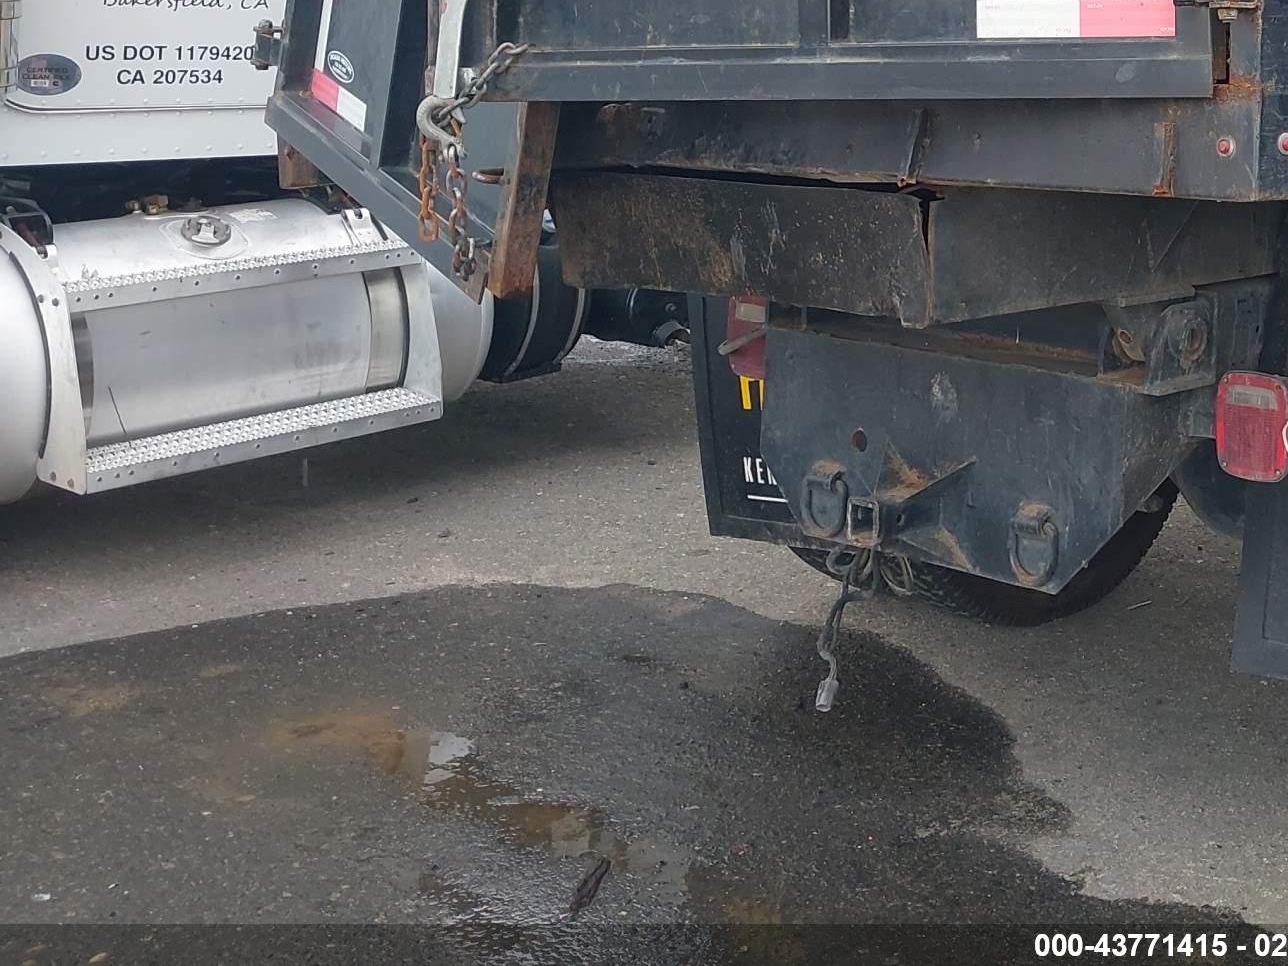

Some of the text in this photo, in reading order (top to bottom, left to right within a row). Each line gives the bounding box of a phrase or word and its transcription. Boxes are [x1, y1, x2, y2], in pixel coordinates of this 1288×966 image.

[85, 45, 254, 62] US DOT 1179420
[117, 69, 223, 85] CA 207534
